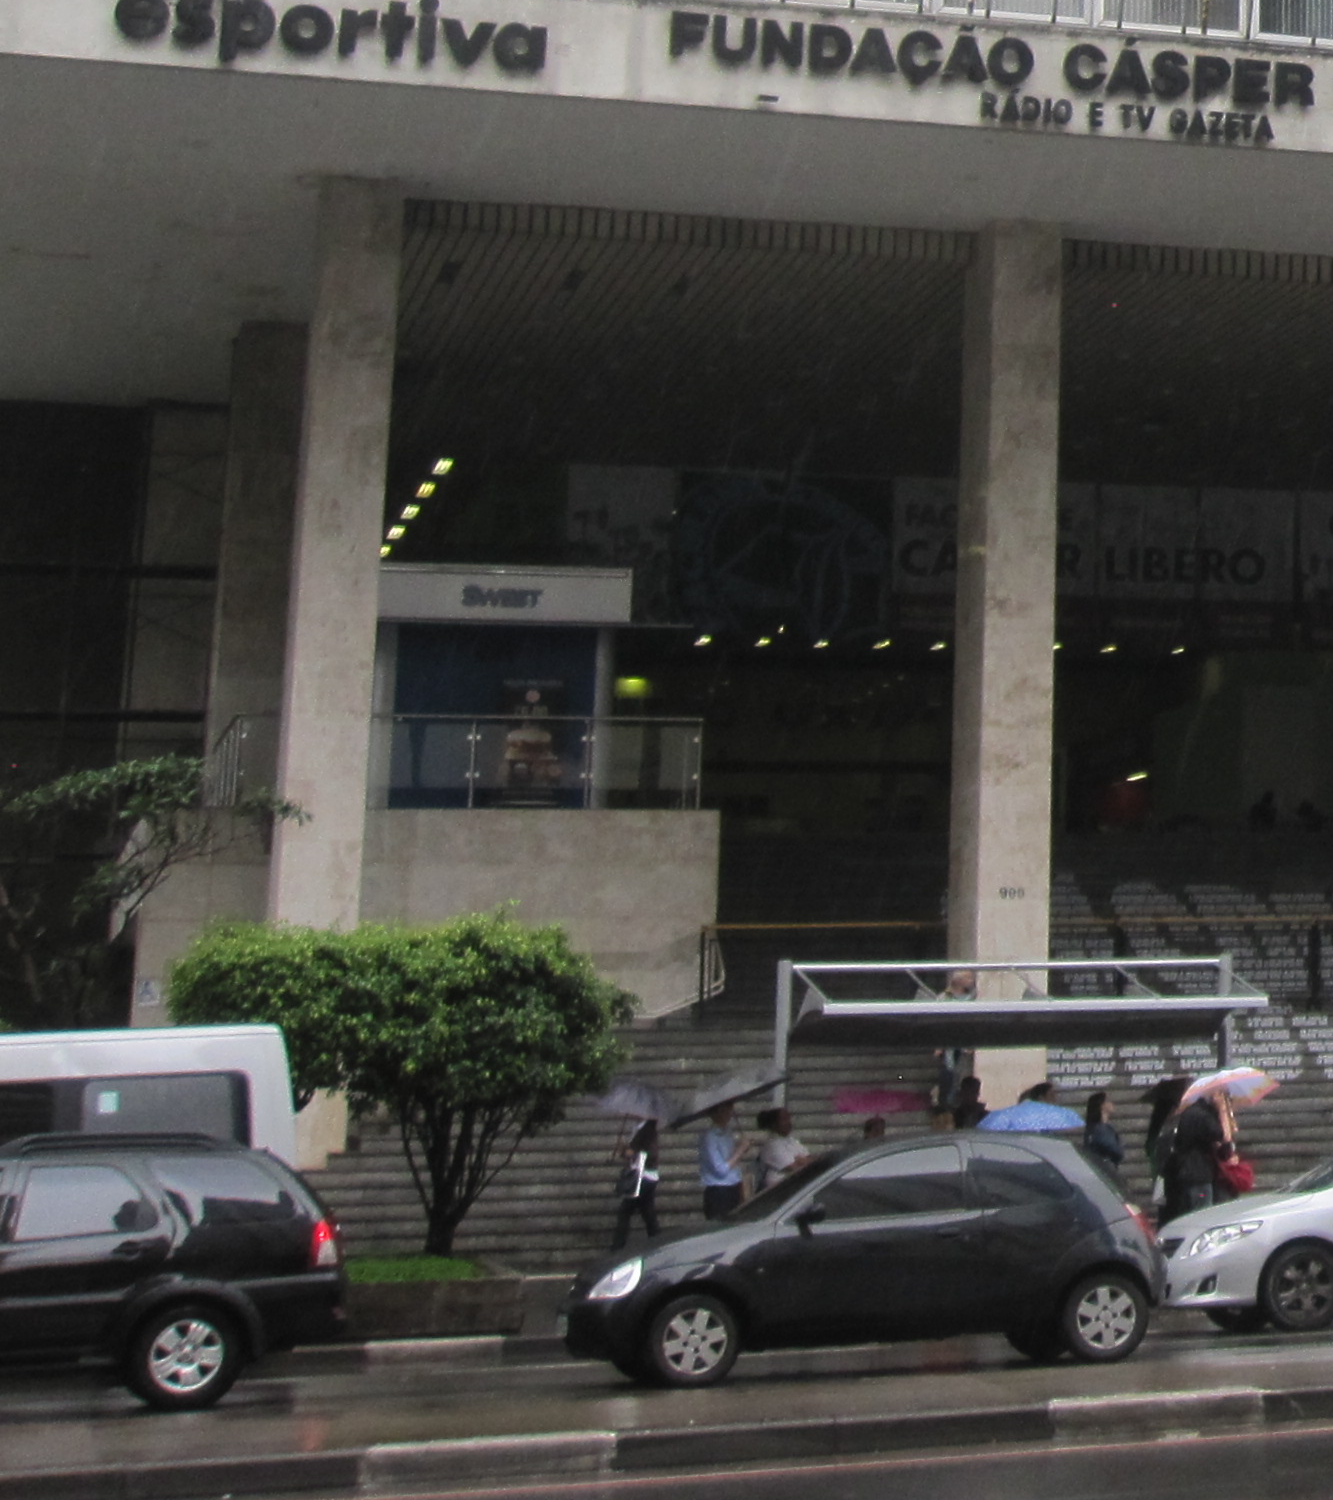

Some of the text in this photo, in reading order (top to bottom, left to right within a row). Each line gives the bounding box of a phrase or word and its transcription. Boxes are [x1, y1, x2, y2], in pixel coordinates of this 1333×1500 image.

[668, 10, 1035, 88] FUNDAÇÃO
[1063, 37, 1315, 108] CÁSPER
[980, 90, 1276, 143] RÁDIO E TV GAZETA
